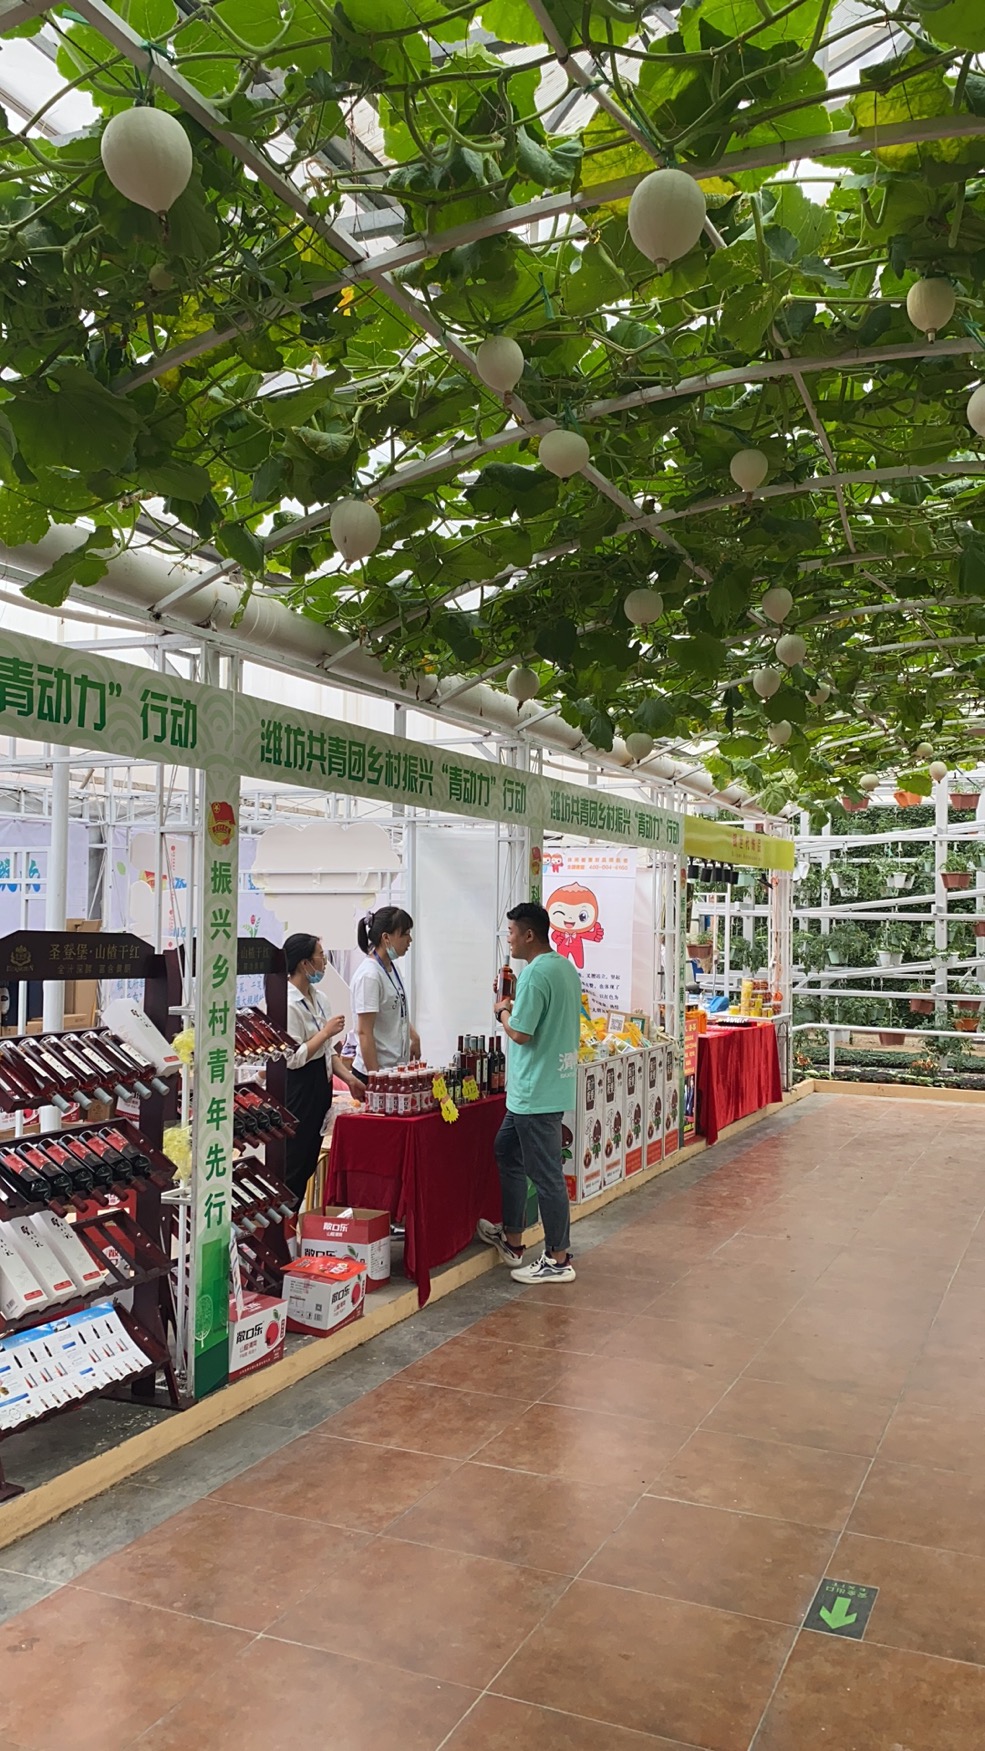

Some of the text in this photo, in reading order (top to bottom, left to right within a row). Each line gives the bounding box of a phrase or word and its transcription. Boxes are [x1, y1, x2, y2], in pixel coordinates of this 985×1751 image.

[203, 860, 233, 1230] 振兴乡村青年先行
